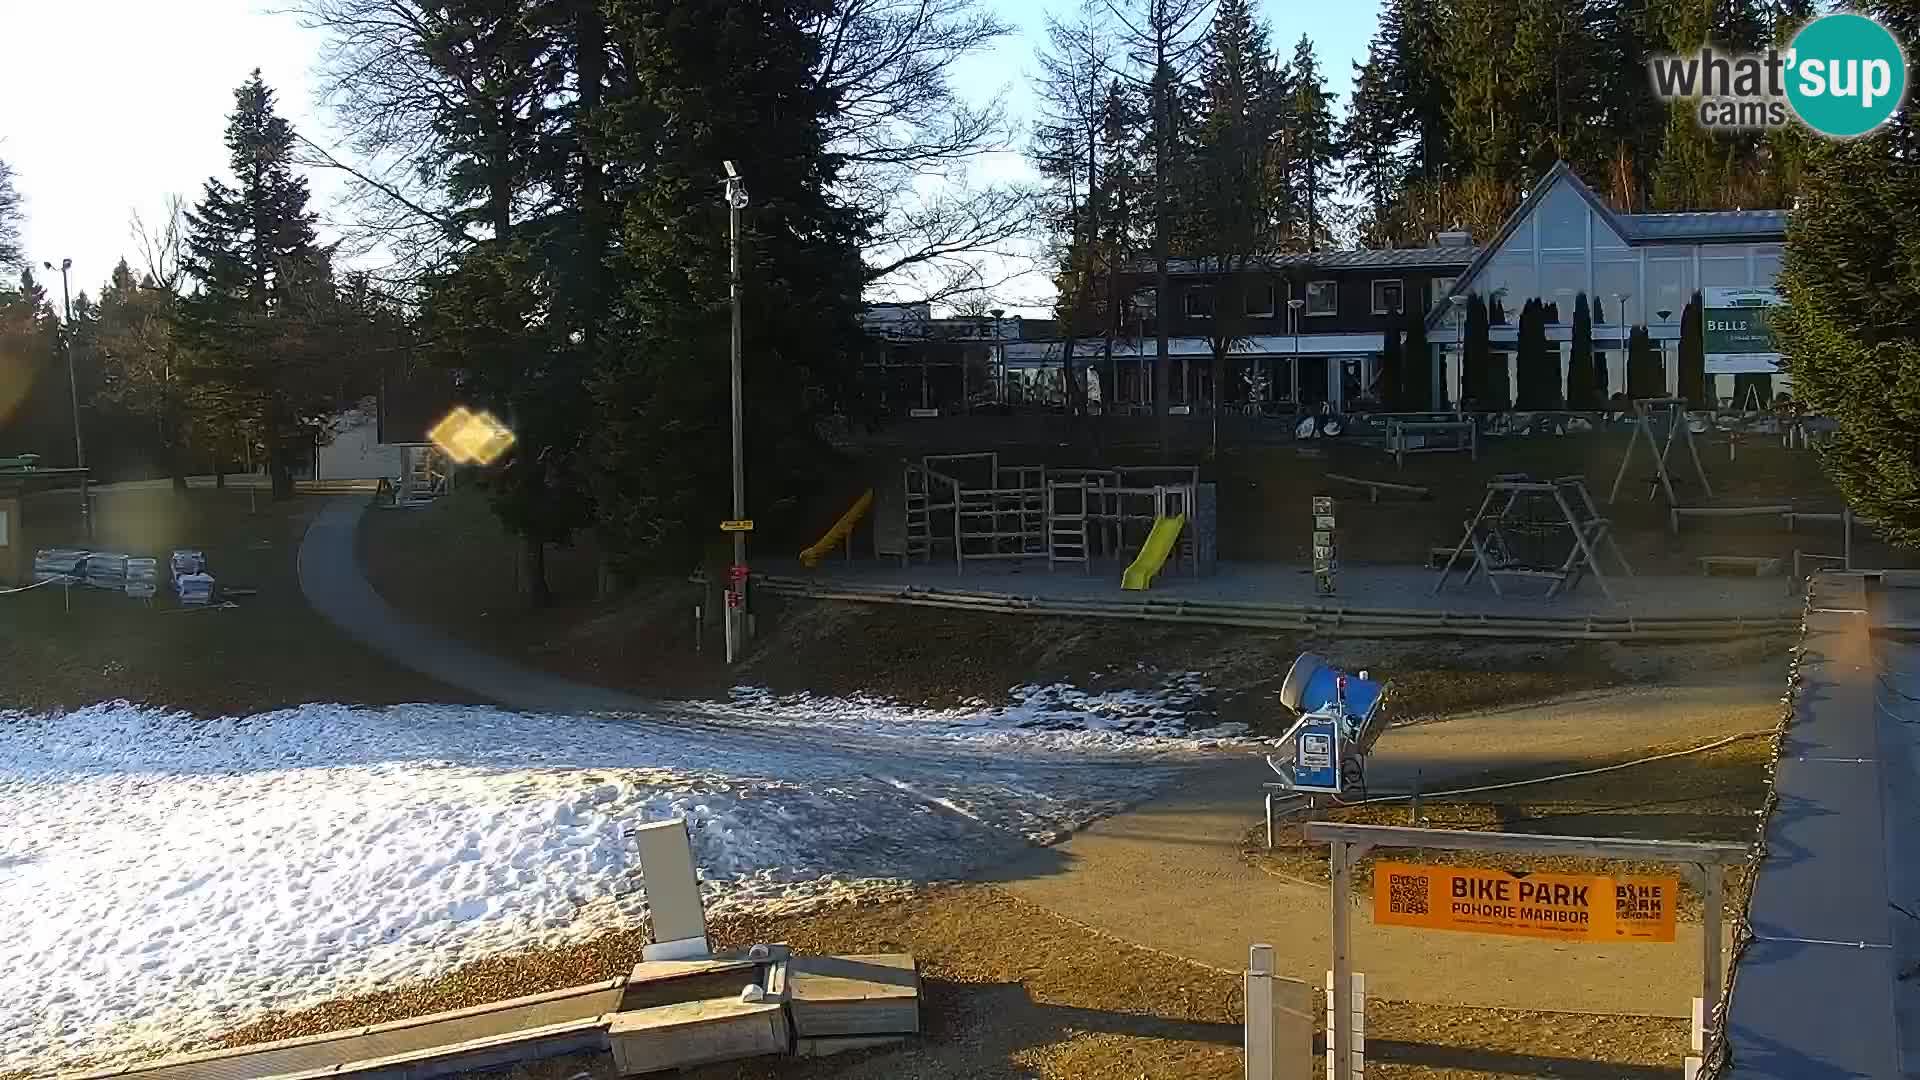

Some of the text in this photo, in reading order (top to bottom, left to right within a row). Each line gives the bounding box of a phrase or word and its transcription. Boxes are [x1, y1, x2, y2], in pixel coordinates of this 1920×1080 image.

[1707, 320, 1748, 331] BELLE
[1451, 876, 1590, 907] BIKE PARK
[1452, 902, 1518, 919] POHORJE
[1520, 907, 1590, 925] MARIBOR
